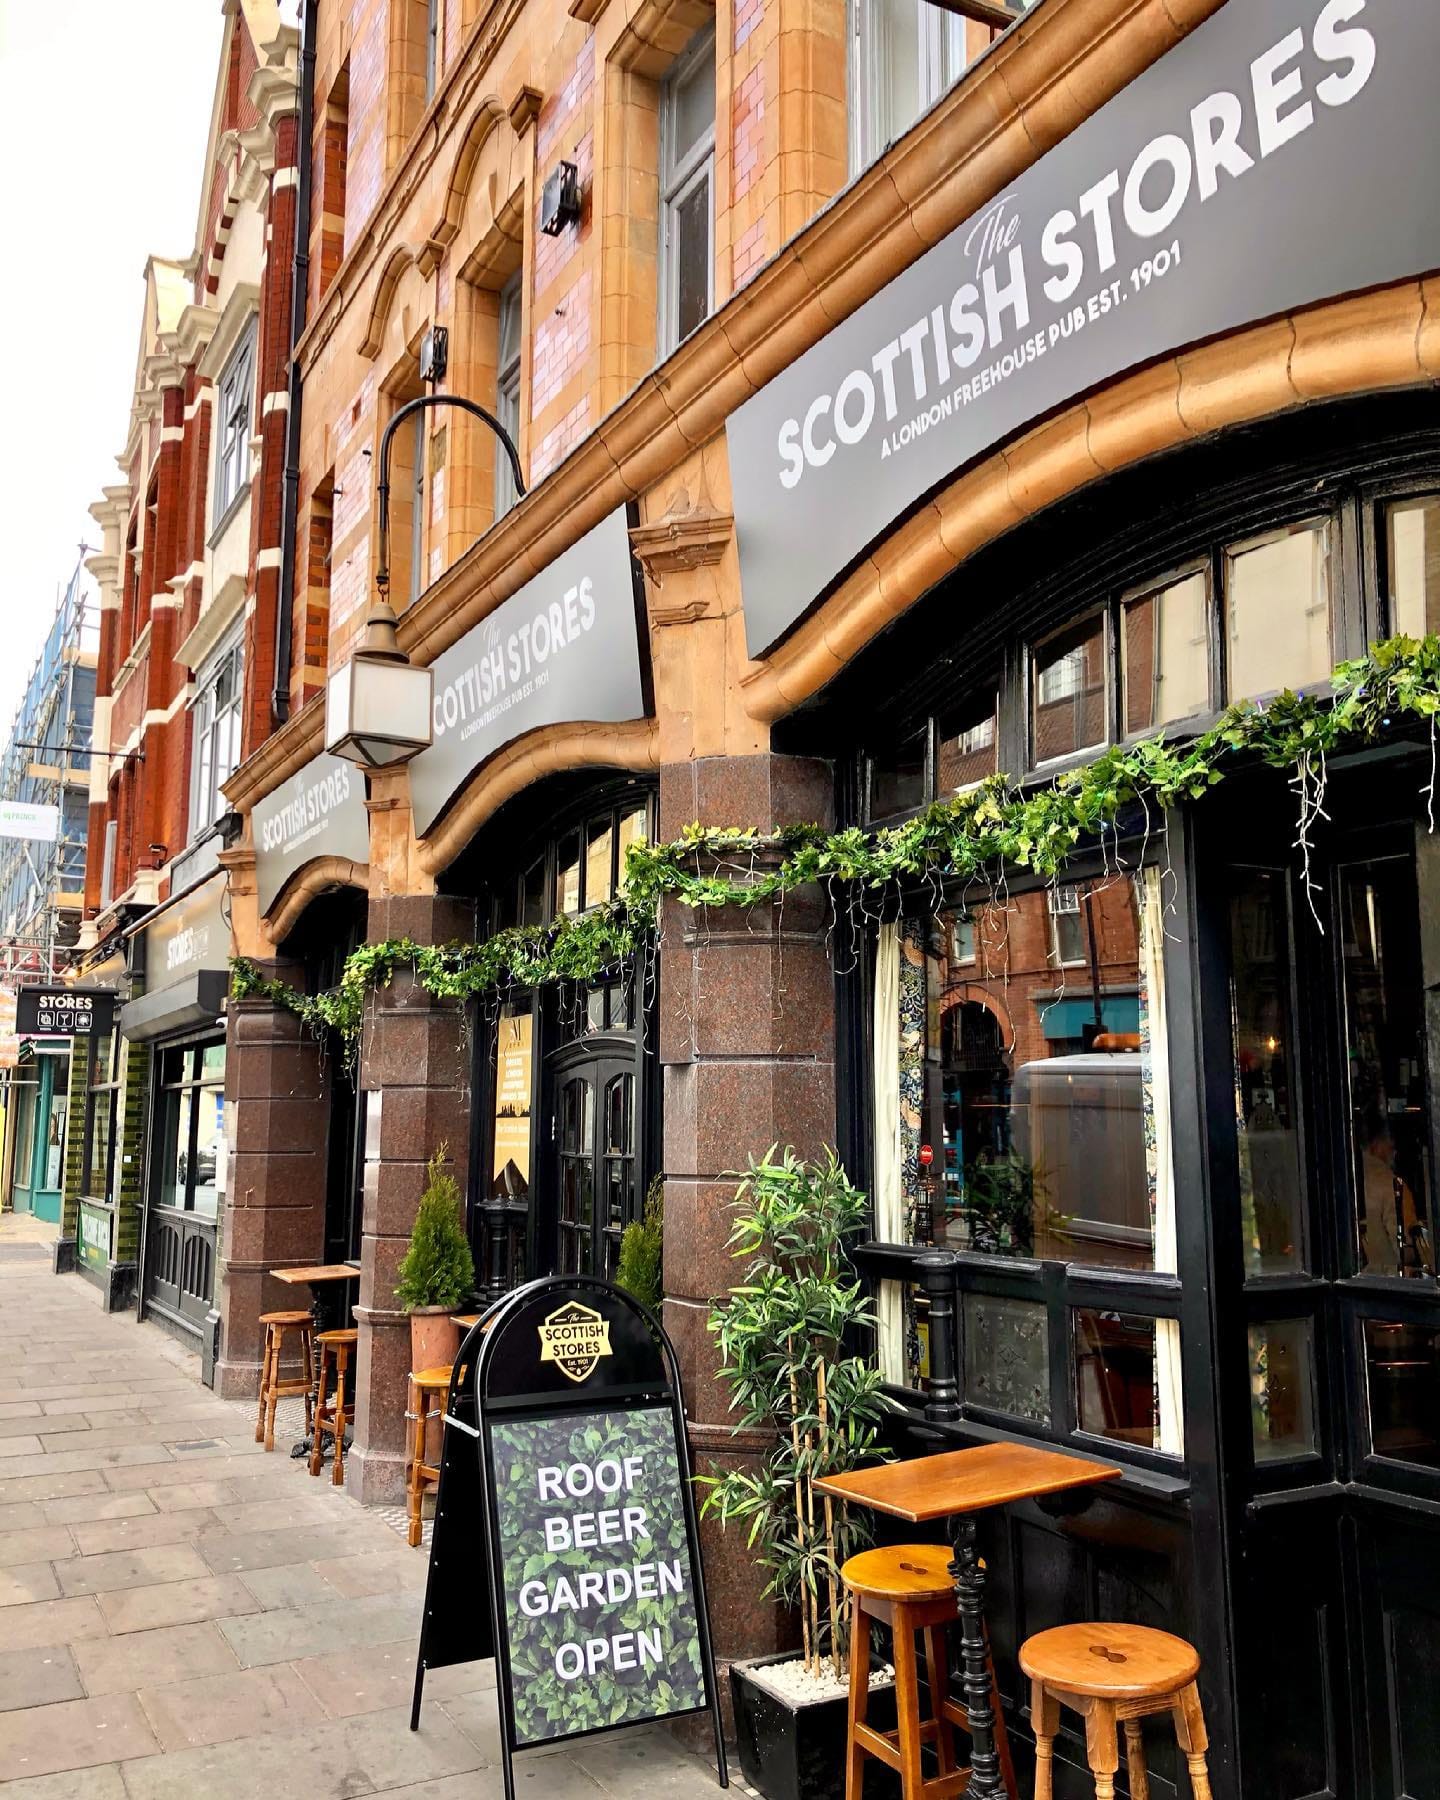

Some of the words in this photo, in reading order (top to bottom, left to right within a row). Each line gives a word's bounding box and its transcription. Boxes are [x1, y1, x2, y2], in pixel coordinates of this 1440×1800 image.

[778, 244, 1031, 489] SCOTTISH
[1043, 0, 1377, 303] STORES
[965, 194, 1018, 280] The
[881, 438, 892, 460] A
[891, 394, 952, 455] LONDON
[953, 330, 1047, 412] FREEHOUSE
[1048, 304, 1086, 348] PUB
[1087, 280, 1128, 321] EST.
[1130, 239, 1182, 293] 1901
[432, 644, 506, 737] COTTISH
[508, 576, 596, 683] STORES
[263, 793, 307, 853] SCOTTISH
[307, 763, 350, 822] STORES
[39, 996, 93, 1009] STORES
[545, 1325, 604, 1341] SCOTTISH
[553, 1341, 600, 1357] STORES
[537, 1456, 645, 1501] ROOF
[544, 1506, 652, 1553] BEER
[518, 1559, 684, 1618] GARDEN
[554, 1627, 663, 1681] OPEN
